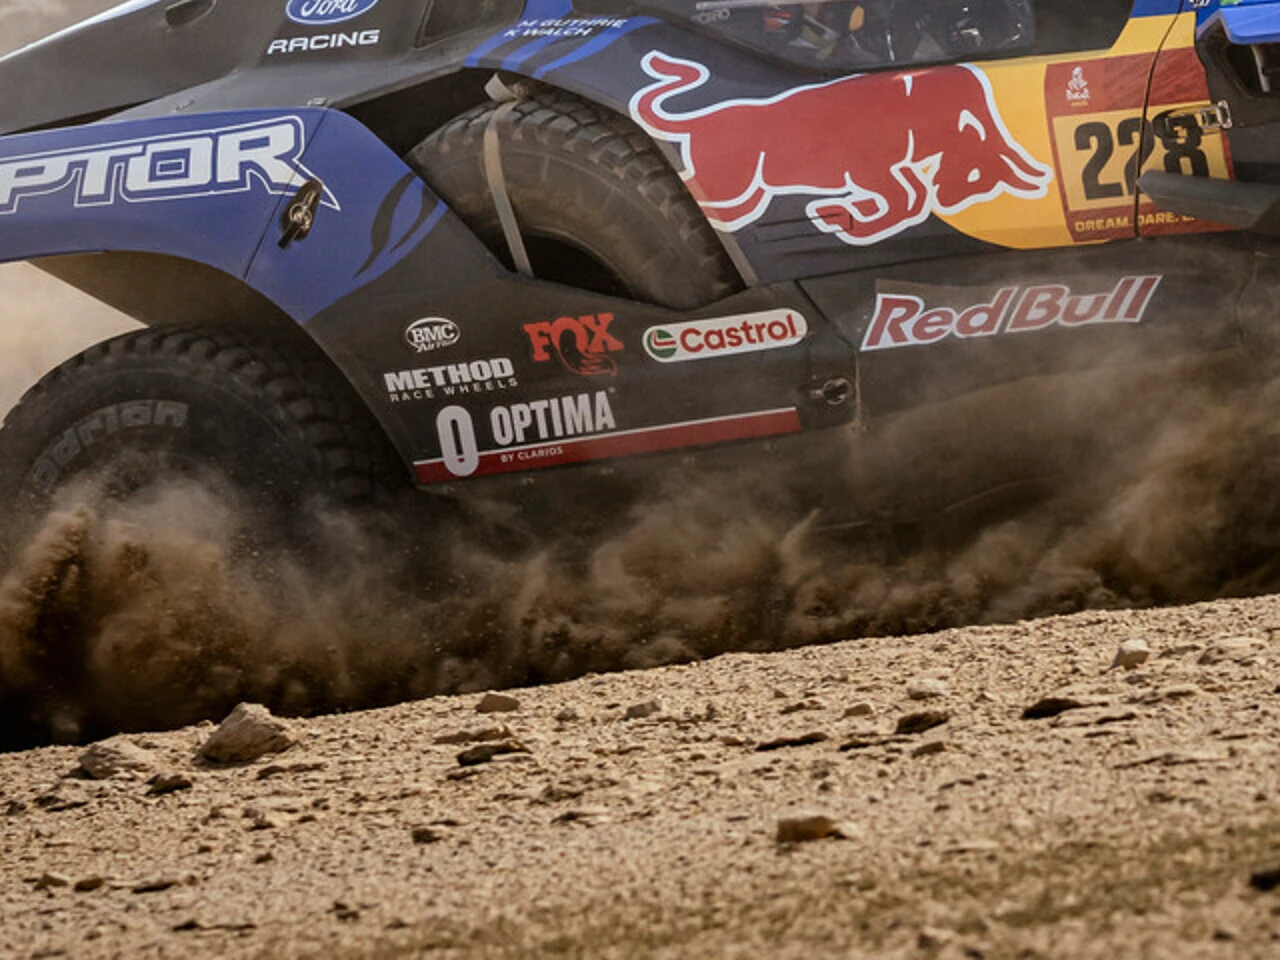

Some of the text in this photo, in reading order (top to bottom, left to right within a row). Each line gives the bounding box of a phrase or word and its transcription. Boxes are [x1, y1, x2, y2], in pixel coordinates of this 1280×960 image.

[267, 29, 380, 55] RACING
[862, 275, 1162, 350] Red Bull
[412, 324, 455, 343] BMC
[523, 312, 625, 363] FOX
[679, 313, 798, 353] Castrol
[383, 358, 514, 392] METHOD
[389, 377, 518, 402] RACE WHEELS
[490, 391, 616, 445] OPTIMA
[500, 446, 564, 462] BY CLARIOS
